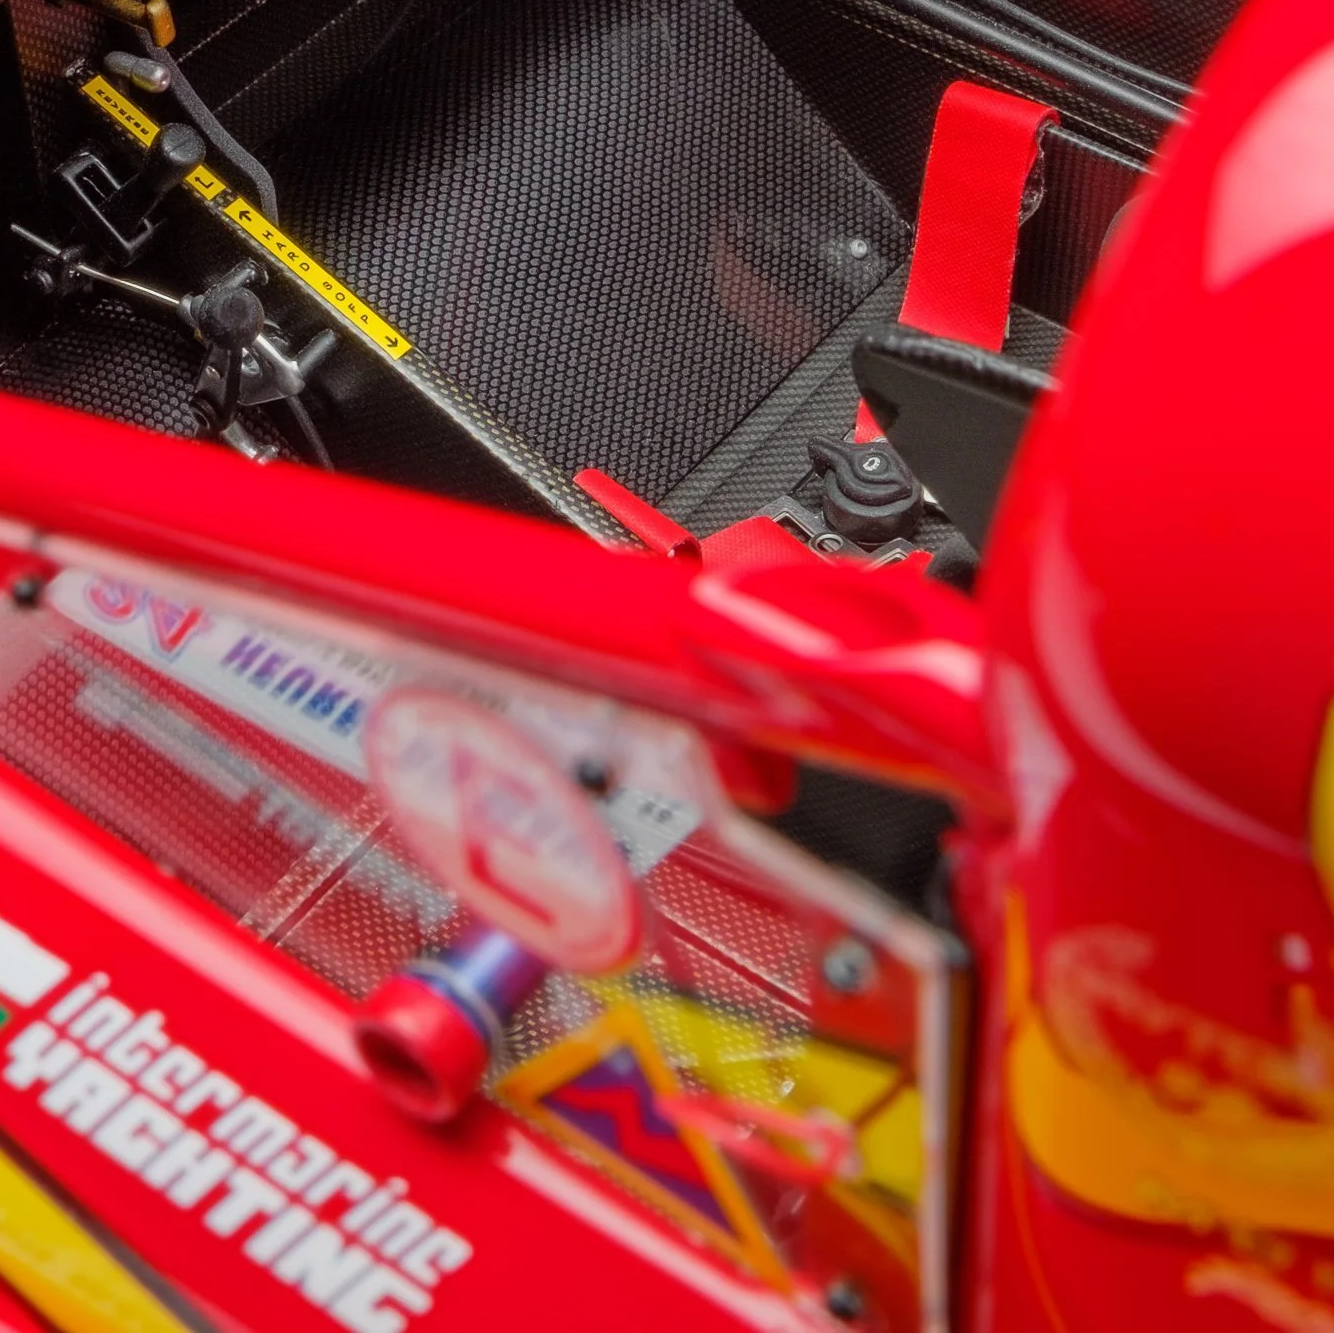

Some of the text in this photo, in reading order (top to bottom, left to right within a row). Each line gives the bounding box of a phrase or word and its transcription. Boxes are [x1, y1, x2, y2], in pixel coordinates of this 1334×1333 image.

[94, 88, 151, 137] REVERSE
[261, 229, 311, 272] HARD
[2, 1018, 433, 1333] YACHTING
[43, 970, 474, 1288] intermarine
